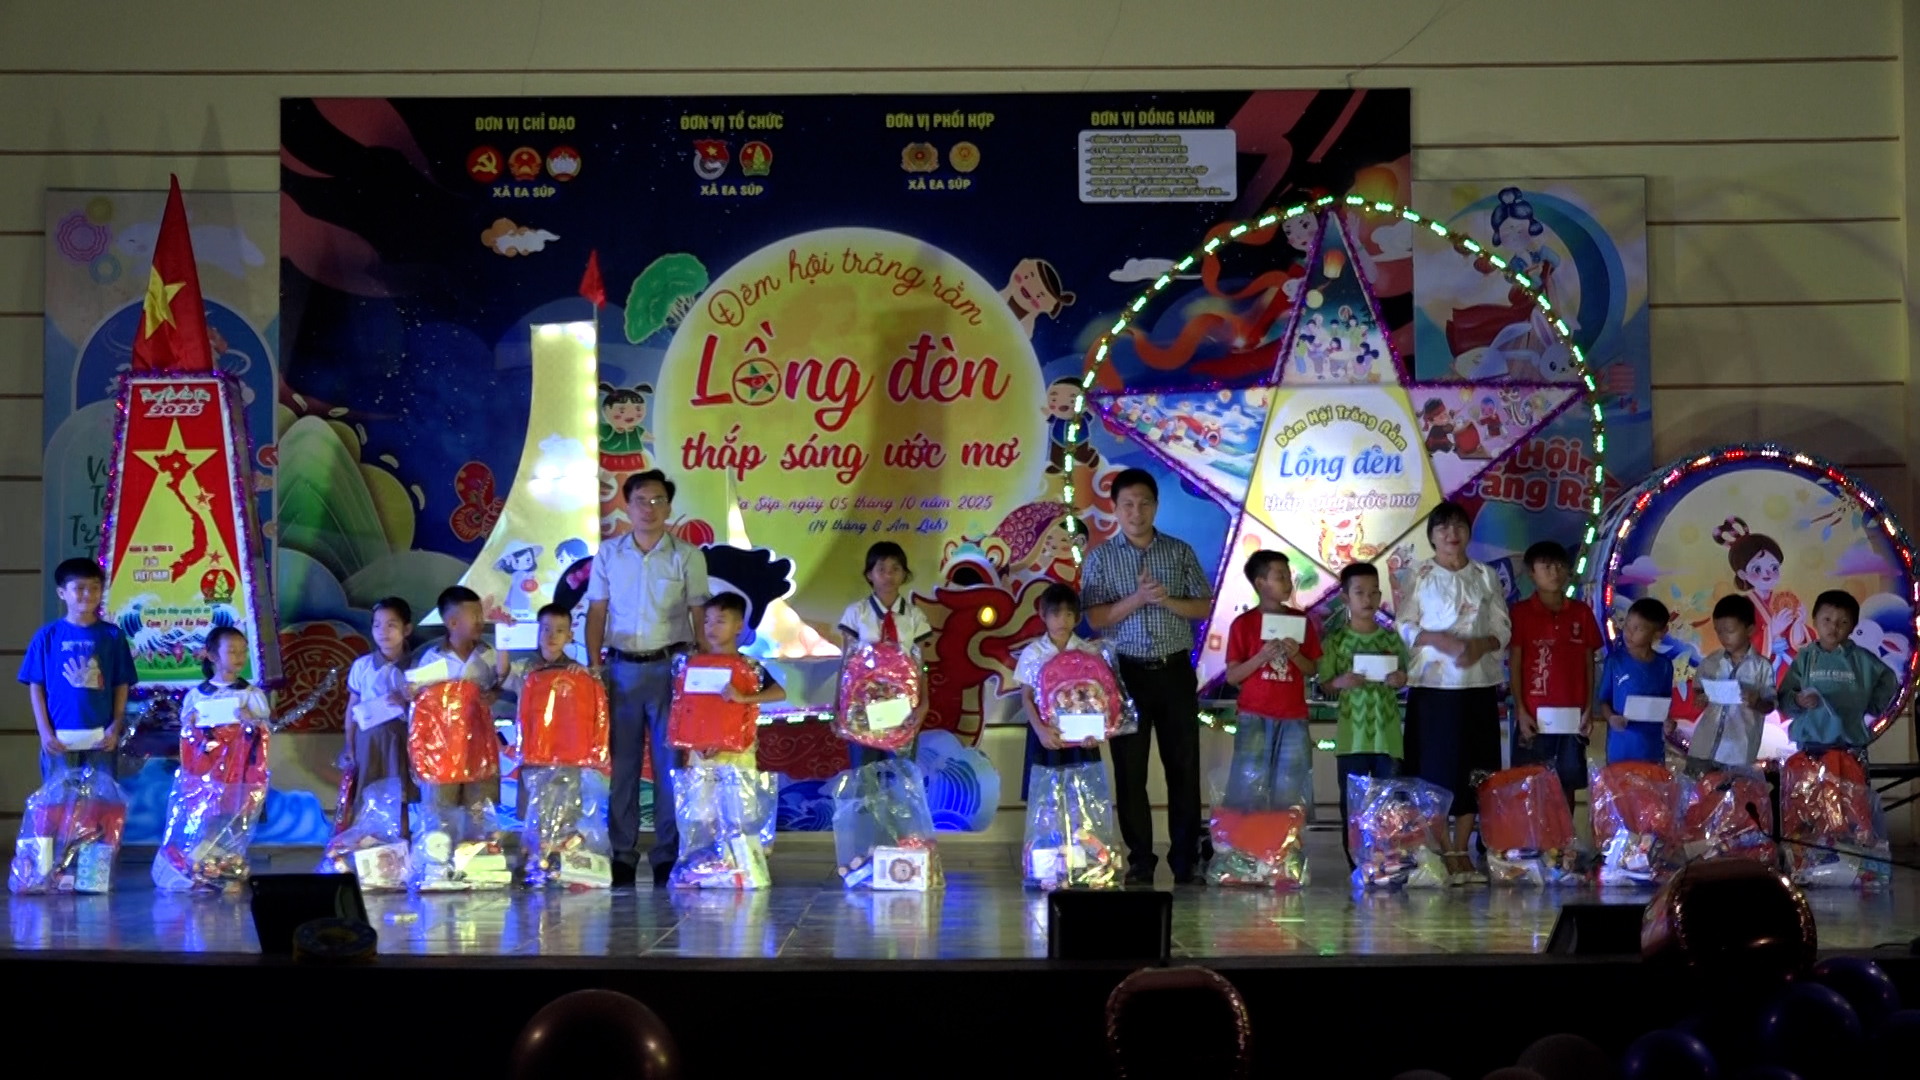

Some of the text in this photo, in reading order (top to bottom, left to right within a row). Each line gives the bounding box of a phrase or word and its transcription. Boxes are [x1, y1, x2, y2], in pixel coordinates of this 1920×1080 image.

[506, 116, 519, 134] VỊ
[522, 111, 546, 131] CHỈ
[680, 113, 709, 130] ĐƠN
[711, 114, 725, 133] VỊ
[748, 112, 784, 130] CHỨC
[885, 108, 996, 132] ĐƠN VỊ PHỐI HỢP
[1090, 109, 1119, 126] ĐƠN
[1121, 111, 1135, 128] VỊ
[1178, 107, 1215, 126] HÀNH
[513, 187, 530, 198] EA
[721, 185, 738, 196] EA
[929, 179, 945, 190] EA
[708, 247, 982, 328] Đêm hội trăng rằm
[690, 320, 1012, 432] Lồng đèn
[148, 403, 204, 417] 2025
[1335, 405, 1378, 431] Trăng
[681, 424, 1021, 486] thắp sáng ước mơ
[1279, 444, 1346, 482] Lồng
[1515, 437, 1581, 481] Hội
[788, 495, 824, 514] ngày
[829, 497, 849, 510] 05
[854, 495, 894, 514] tháng
[899, 495, 917, 510] 10
[920, 495, 951, 509] năm
[957, 495, 994, 510] 2025
[832, 519, 868, 534] tháng
